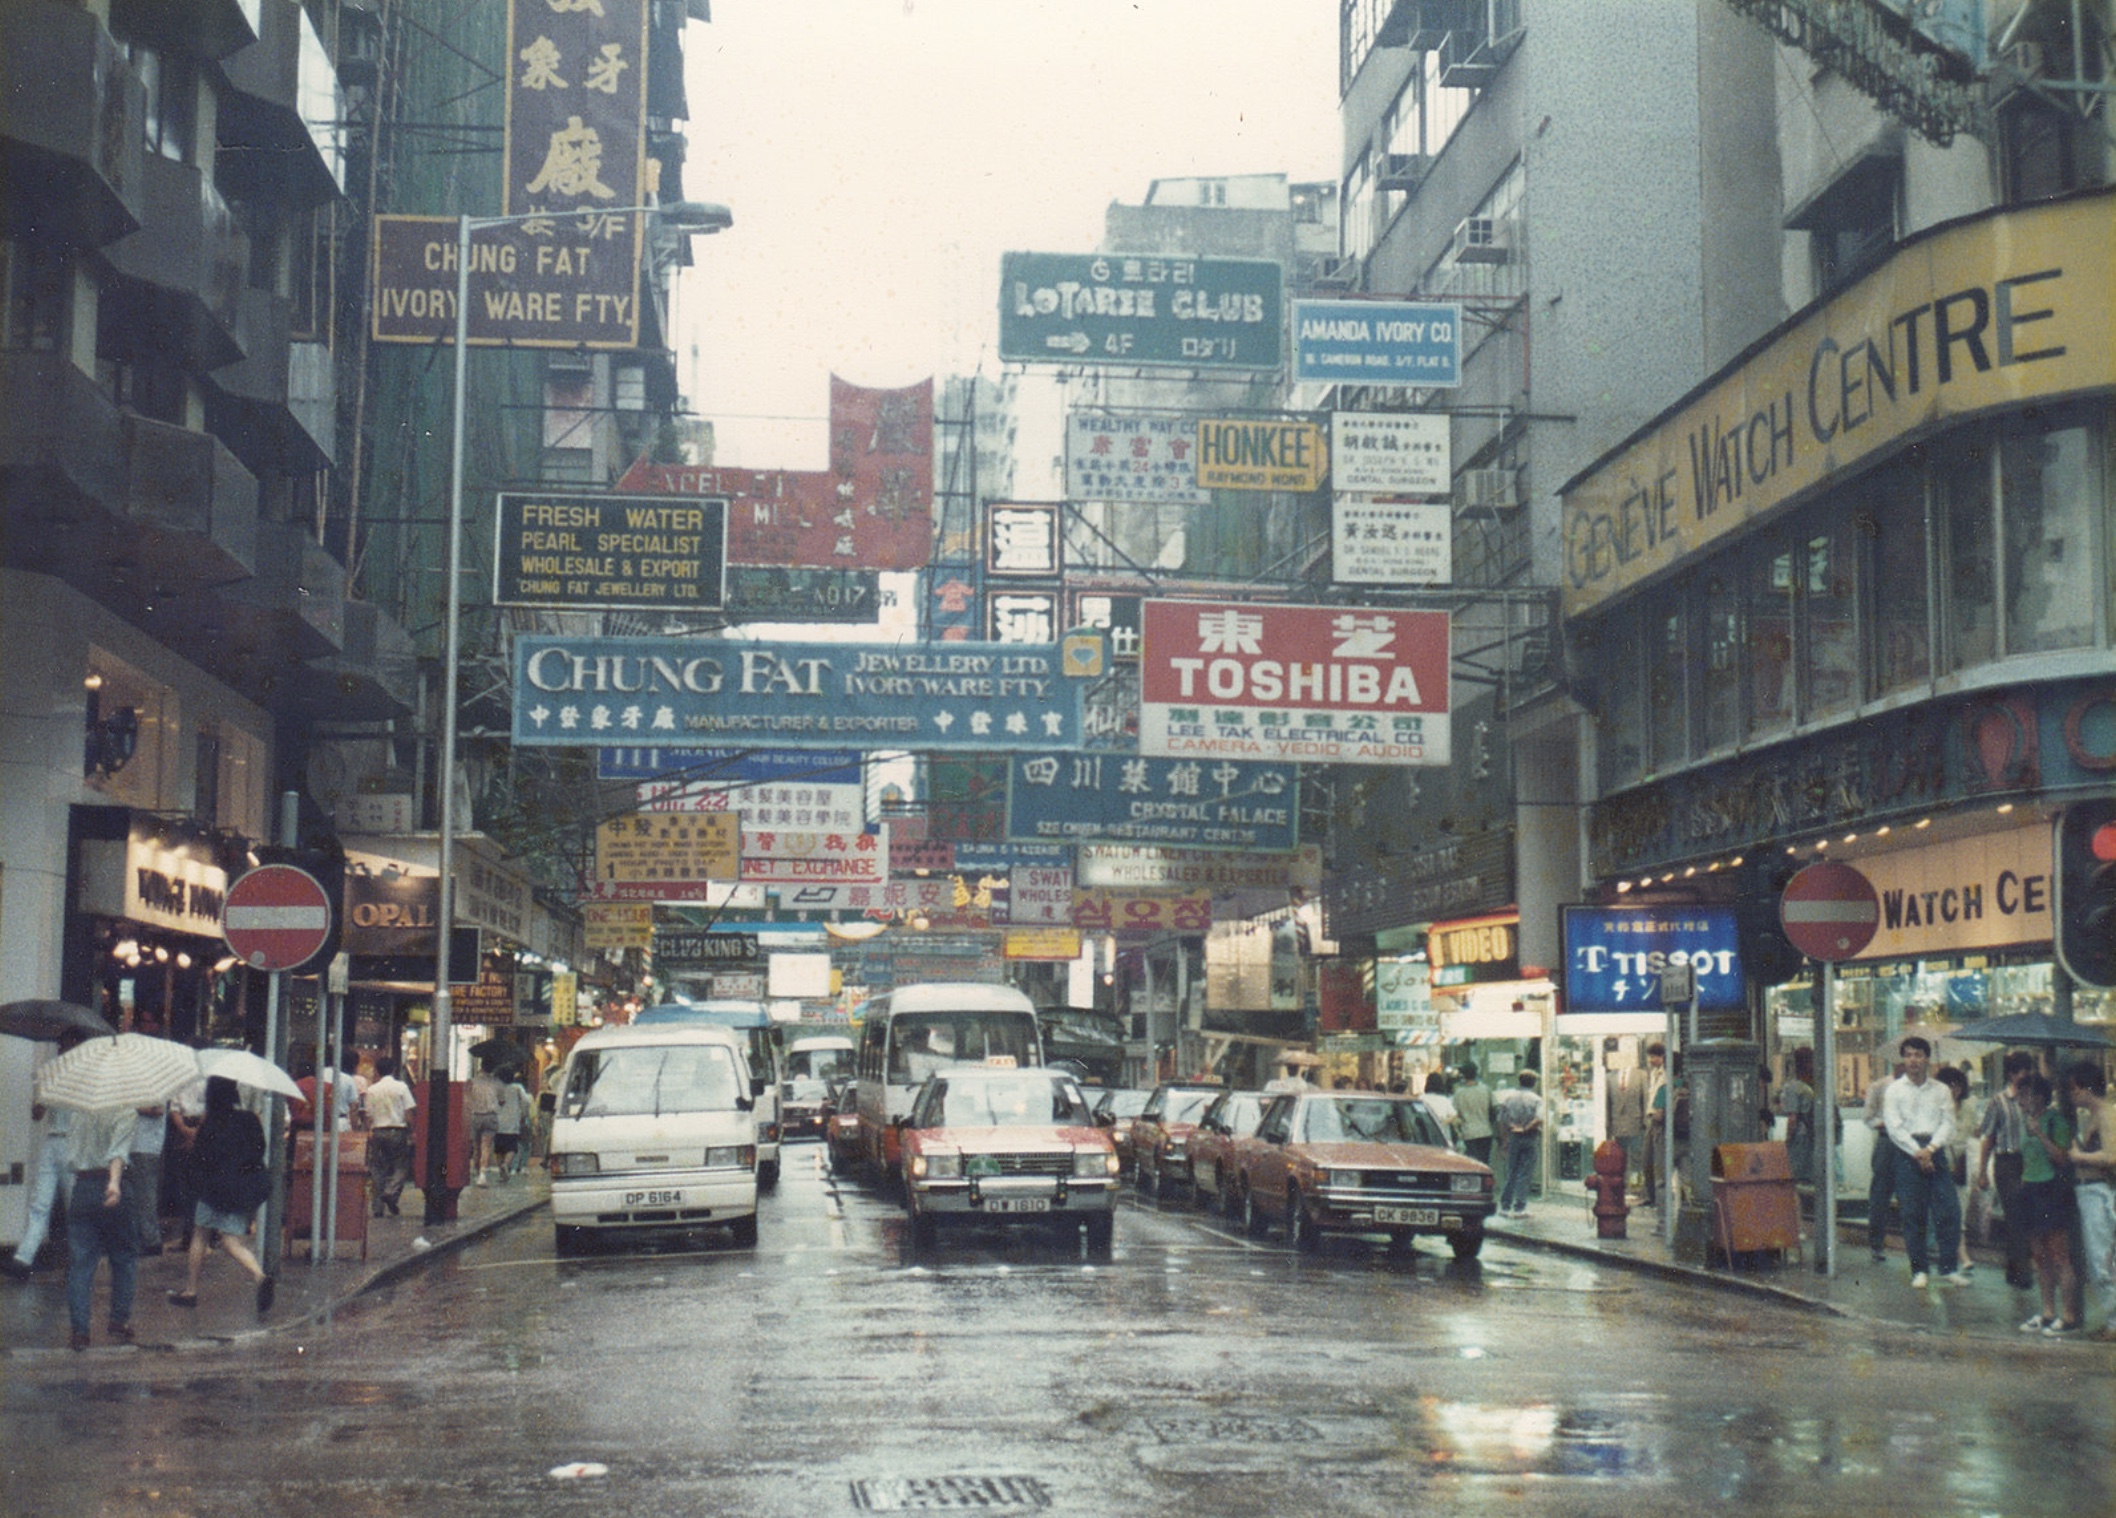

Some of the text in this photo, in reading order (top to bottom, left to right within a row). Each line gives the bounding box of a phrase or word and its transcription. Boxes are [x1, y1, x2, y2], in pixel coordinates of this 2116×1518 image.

[424, 242, 591, 275] CHUNG FAT
[382, 288, 632, 326] IVORY WARE FTY.
[1171, 289, 1264, 323] CLUB
[1301, 319, 1370, 342] AMANDA
[1376, 322, 1425, 343] IVORY
[1104, 333, 1134, 354] 4F
[1688, 393, 1793, 519] WATCH
[1807, 268, 2068, 445] CENTRE
[1202, 425, 1310, 468] HONKEE
[522, 505, 704, 531] FRESH WATER
[521, 531, 702, 555] PEARL SPECIALIST
[521, 556, 700, 578] WHOLESALE & EXPORT
[520, 580, 700, 598] CHUNG FAT JEWELLERY LTD.
[1198, 610, 1396, 659] 東芝
[527, 648, 832, 694] CHUNG FAT
[854, 651, 996, 673] JEWELLERY
[845, 674, 918, 695] IVORY
[922, 678, 993, 696] WARE
[1170, 657, 1422, 704] TOSHIBA
[684, 714, 919, 731] MANUFACTURER & EXPORTER
[1168, 725, 1205, 738] LEE
[1219, 727, 1254, 739] TAK
[1264, 728, 1385, 744] ELECTRICAL
[1168, 738, 1423, 758] CAMERA VEDIO AUDIO
[773, 755, 810, 765] BEAUTY
[1023, 756, 1287, 796] 四川菜館中心
[1131, 802, 1288, 825] CRYSTAL PALACE
[792, 858, 876, 875] EXCHANGE
[1030, 869, 1071, 888] SWAT
[1018, 888, 1072, 903] WHOLES
[1883, 869, 2053, 930] WATCH CE
[352, 903, 434, 928] OPAL
[704, 938, 757, 958] KING'S
[1450, 926, 1509, 965] VIDEO
[1611, 949, 1736, 976] TISSOT
[626, 1190, 682, 1204] DP 6164
[1378, 1209, 1395, 1221] CK
